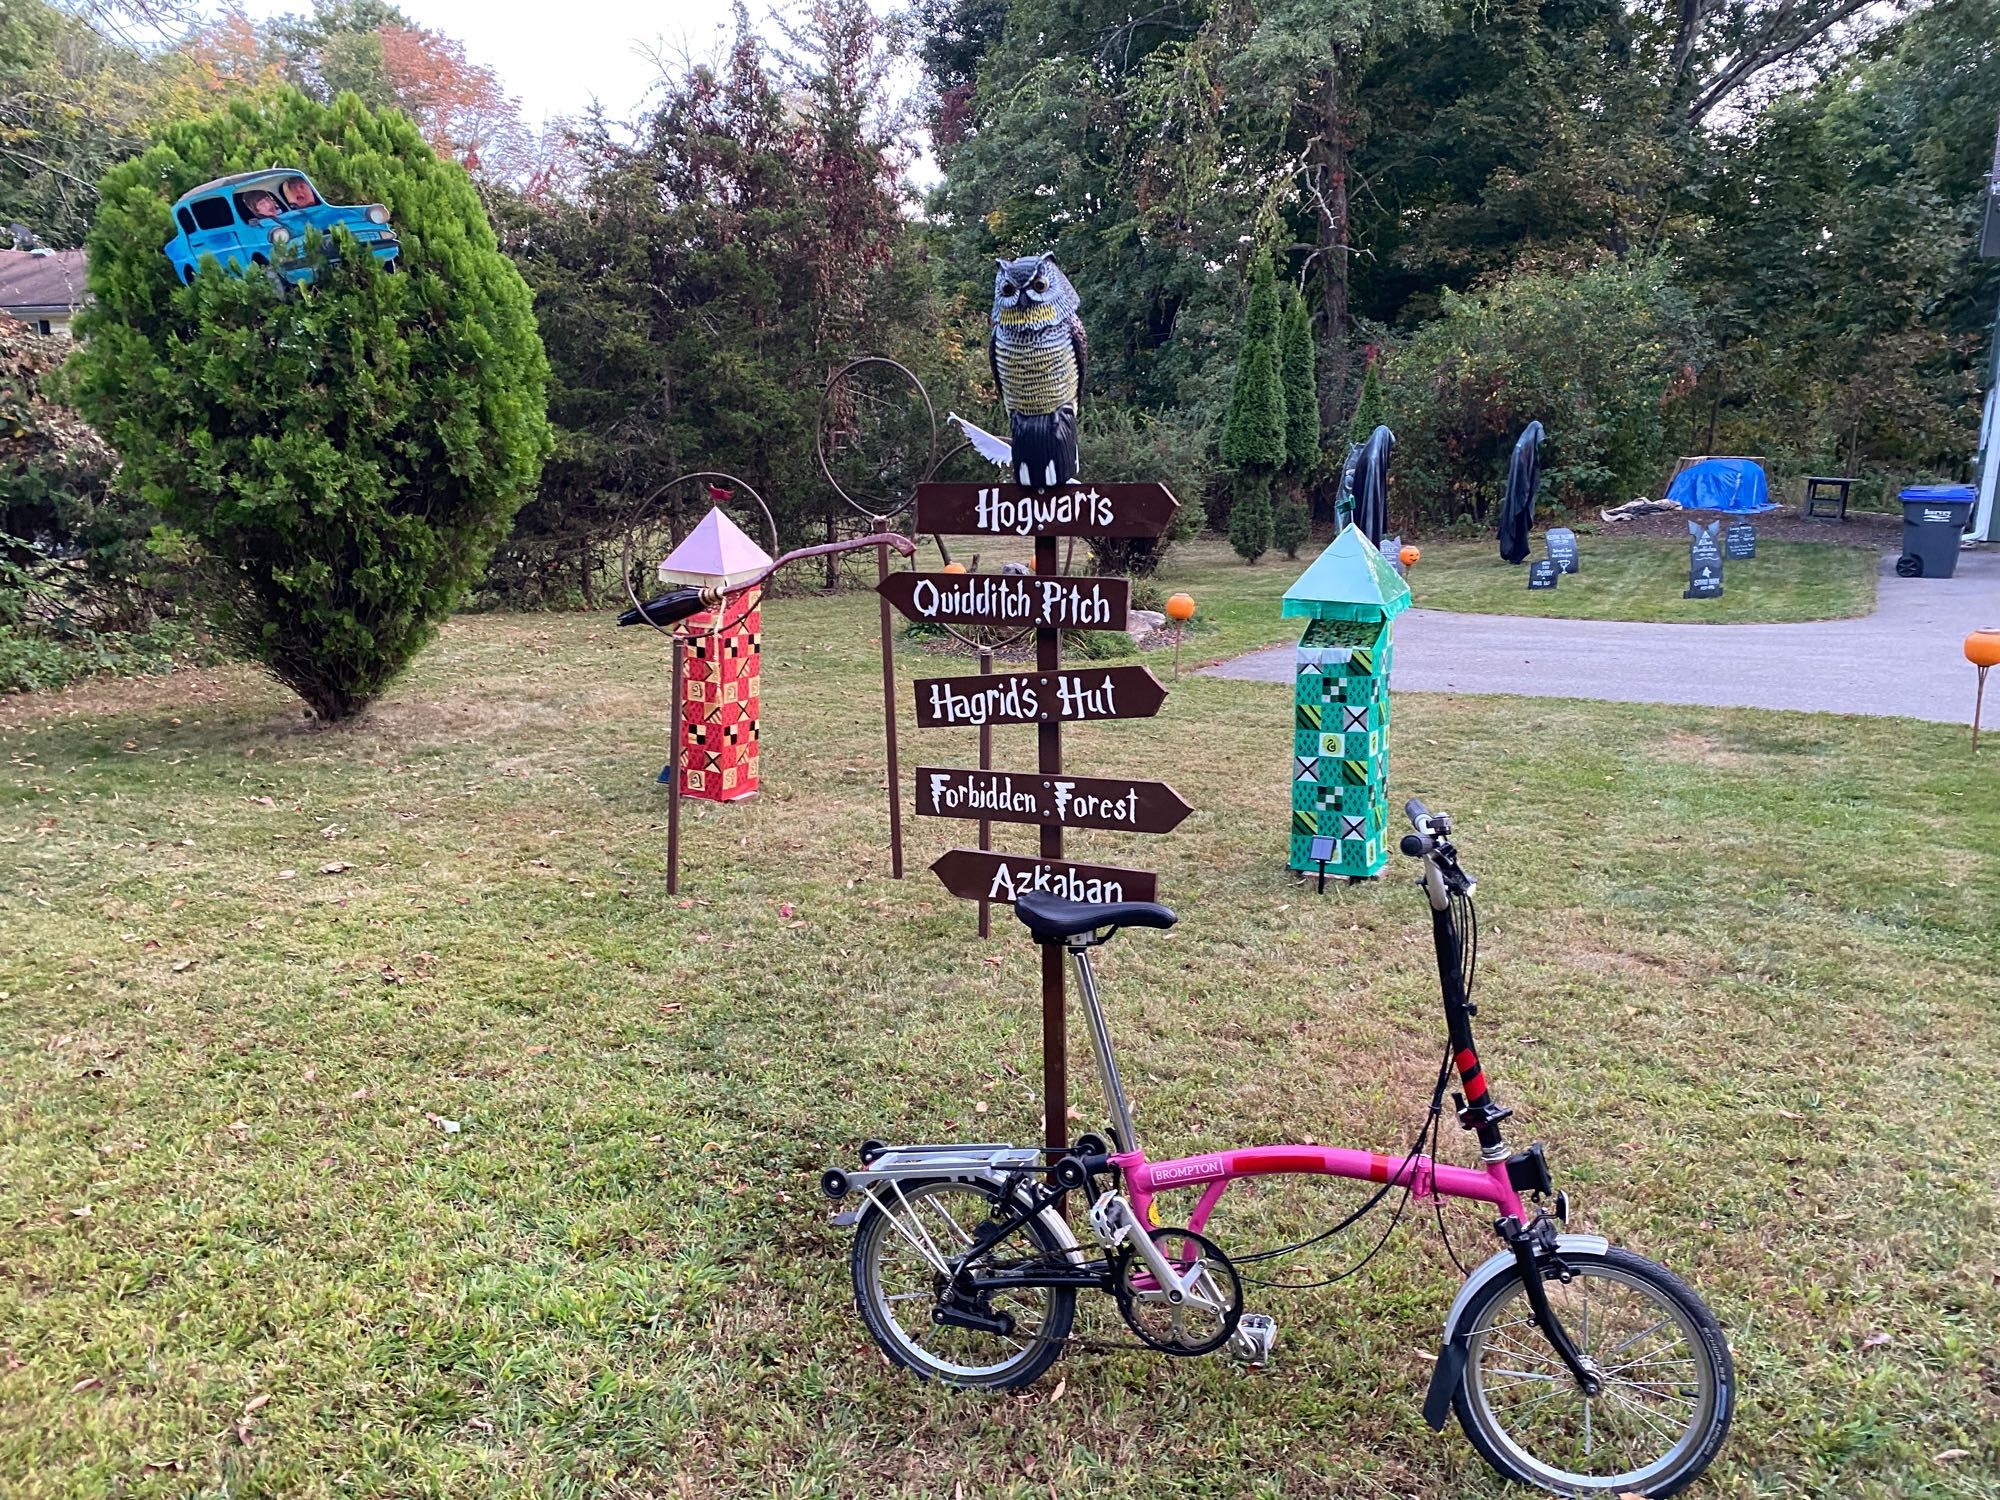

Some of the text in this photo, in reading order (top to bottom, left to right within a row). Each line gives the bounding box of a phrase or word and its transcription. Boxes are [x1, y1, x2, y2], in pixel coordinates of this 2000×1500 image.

[975, 487, 1114, 536] Hogwarts
[913, 578, 1110, 625] Quidditch Pitch
[930, 674, 1117, 725] Hagrid's Hut
[930, 773, 1139, 824] Forbidden Forest
[988, 863, 1123, 904] Azkaban
[1156, 1162, 1218, 1180] BROMPTON
